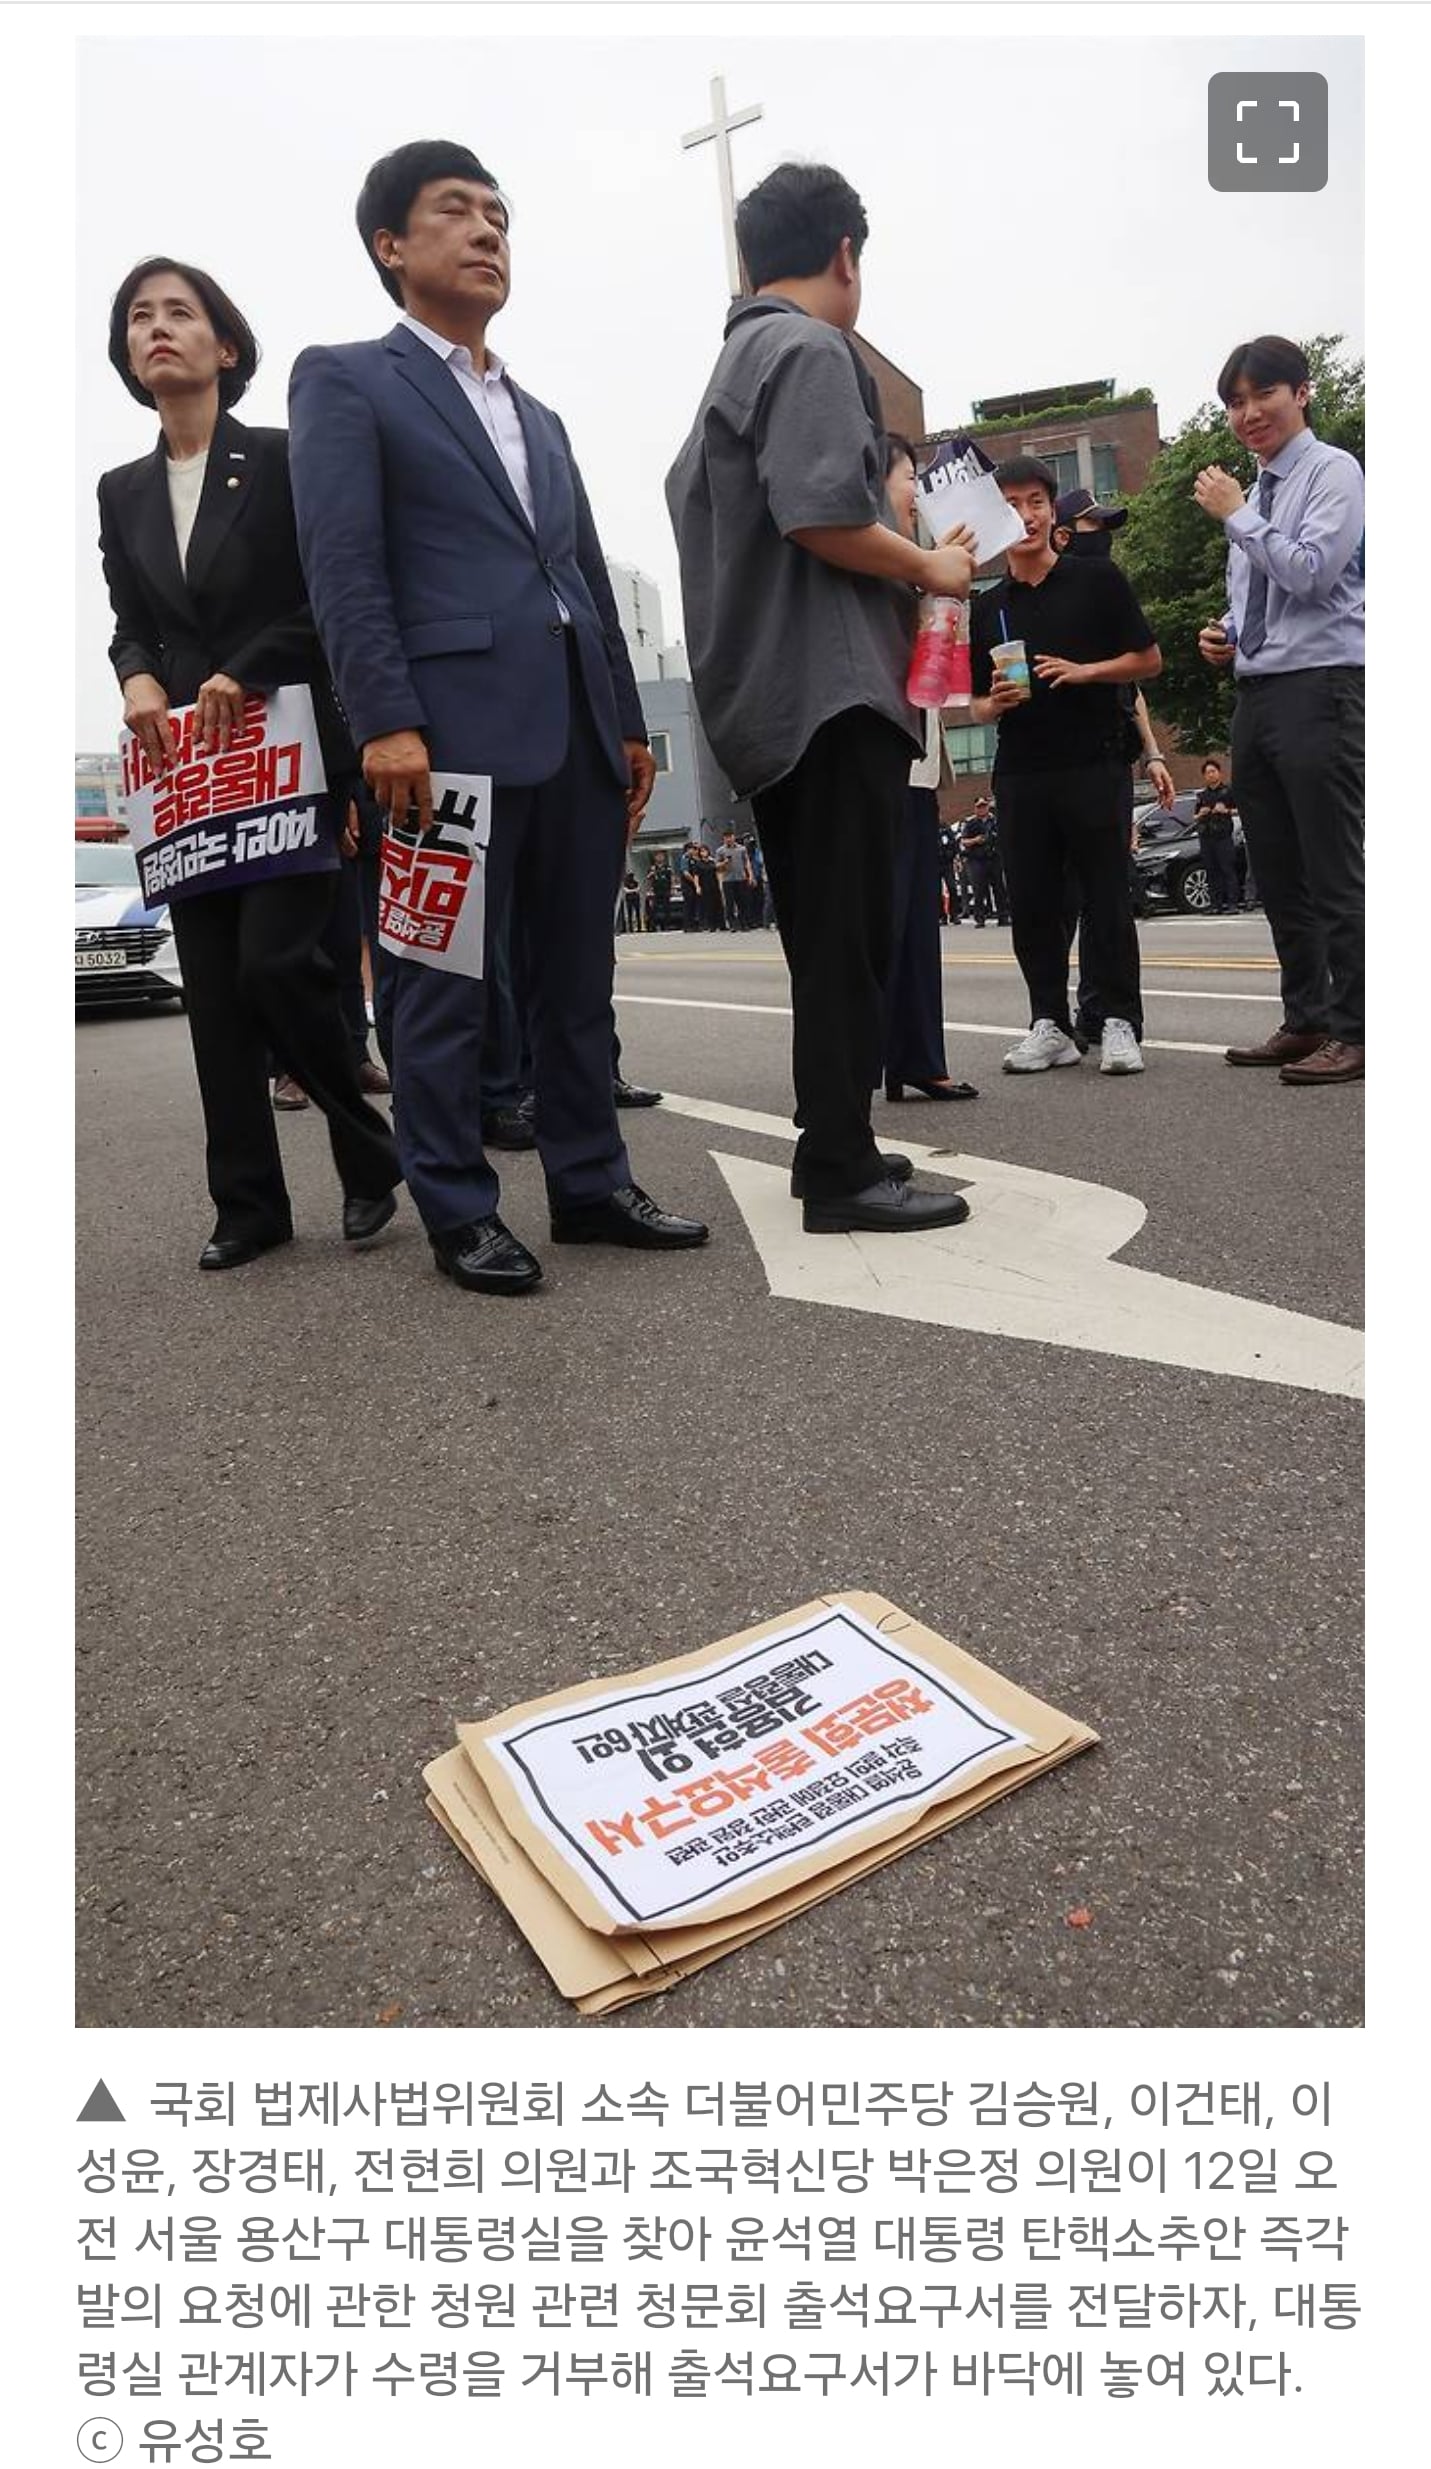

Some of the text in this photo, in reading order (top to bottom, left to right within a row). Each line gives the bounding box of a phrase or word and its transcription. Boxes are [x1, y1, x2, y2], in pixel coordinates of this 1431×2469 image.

[153, 743, 301, 837] 대통령은
[142, 807, 318, 899] 140만 국민청원
[87, 952, 121, 966] 5032
[385, 905, 447, 947] 윤석열
[570, 1648, 834, 1766] 대통령실 관계자 6인
[638, 1692, 823, 1783] 김용현 외
[798, 1678, 935, 1758] 청문회
[880, 1735, 922, 1759] 즉각
[584, 1737, 817, 1856] 출석요구서
[845, 1751, 887, 1777] 발의
[711, 1760, 922, 1868] 윤석열 대통령 탄핵소추안
[748, 1798, 793, 1827] 관한
[664, 1840, 712, 1867] 관련
